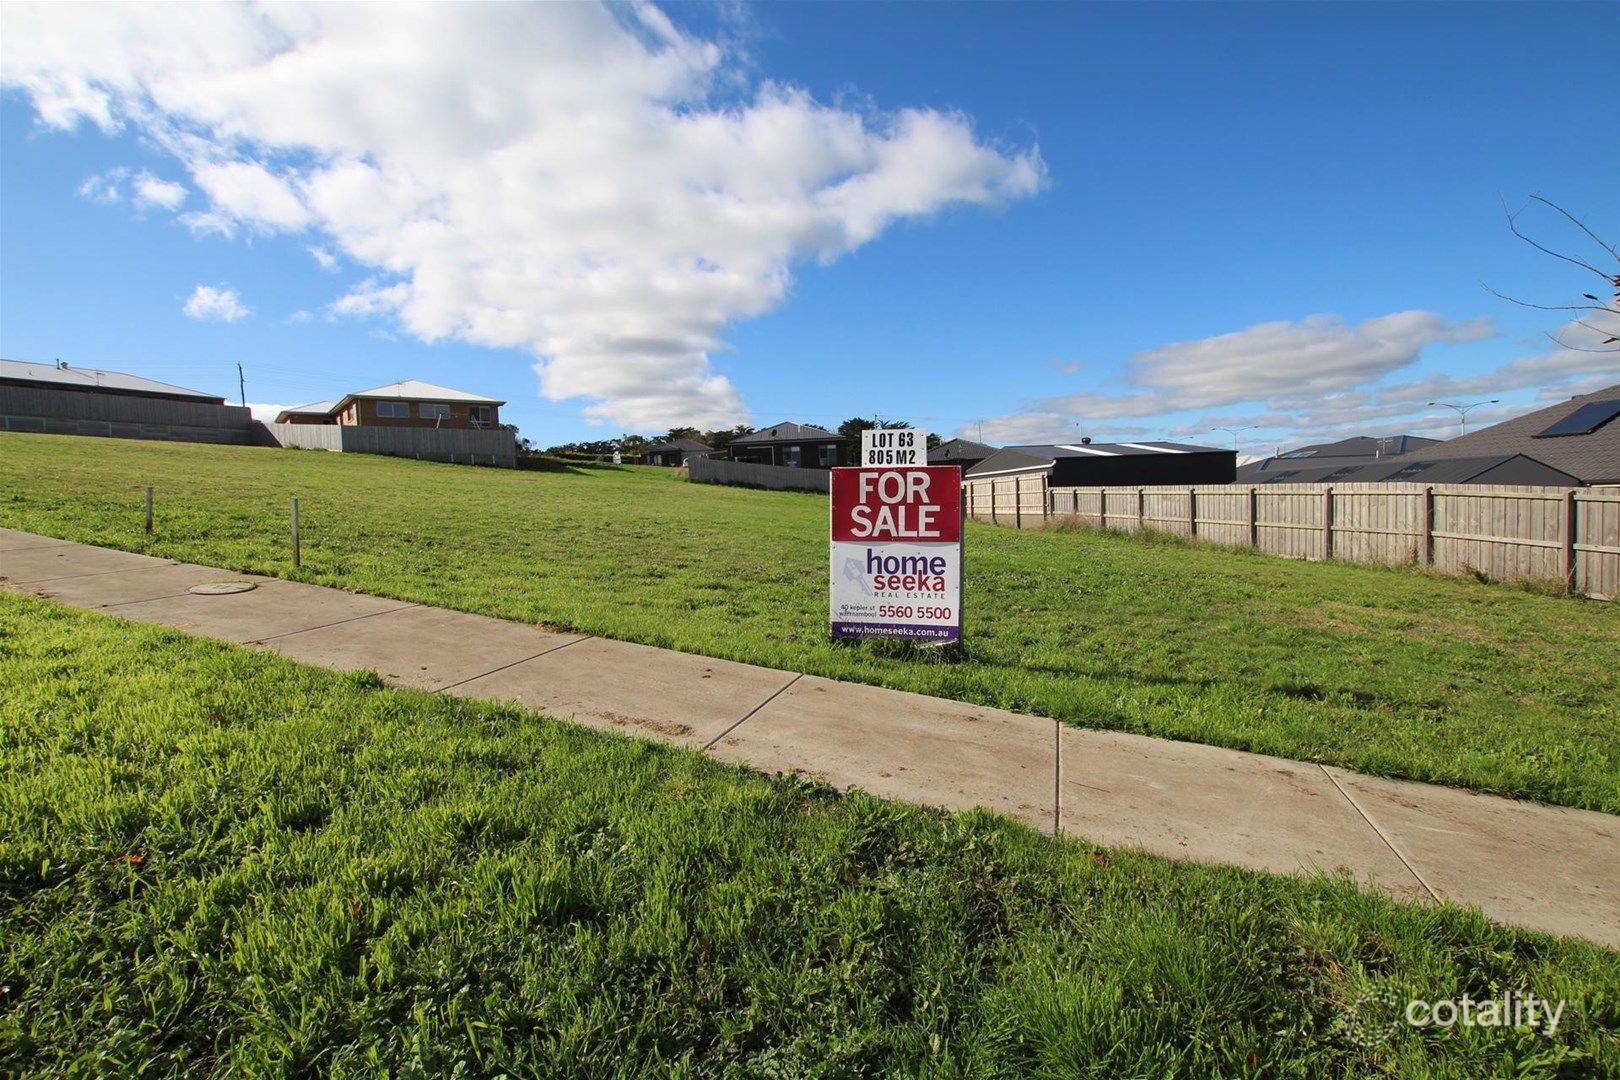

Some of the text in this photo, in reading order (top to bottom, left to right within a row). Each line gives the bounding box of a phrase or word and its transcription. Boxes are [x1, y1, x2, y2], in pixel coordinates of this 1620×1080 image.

[872, 433, 914, 448] LOT 63
[868, 450, 916, 465] 805 M2
[859, 471, 931, 504] FOR
[850, 505, 940, 537] SALE
[867, 549, 946, 575] home
[874, 570, 945, 591] seeka
[850, 604, 868, 612] kepler
[879, 606, 952, 620] 5560 5500
[841, 626, 949, 637] www.homeseeka.com.au
